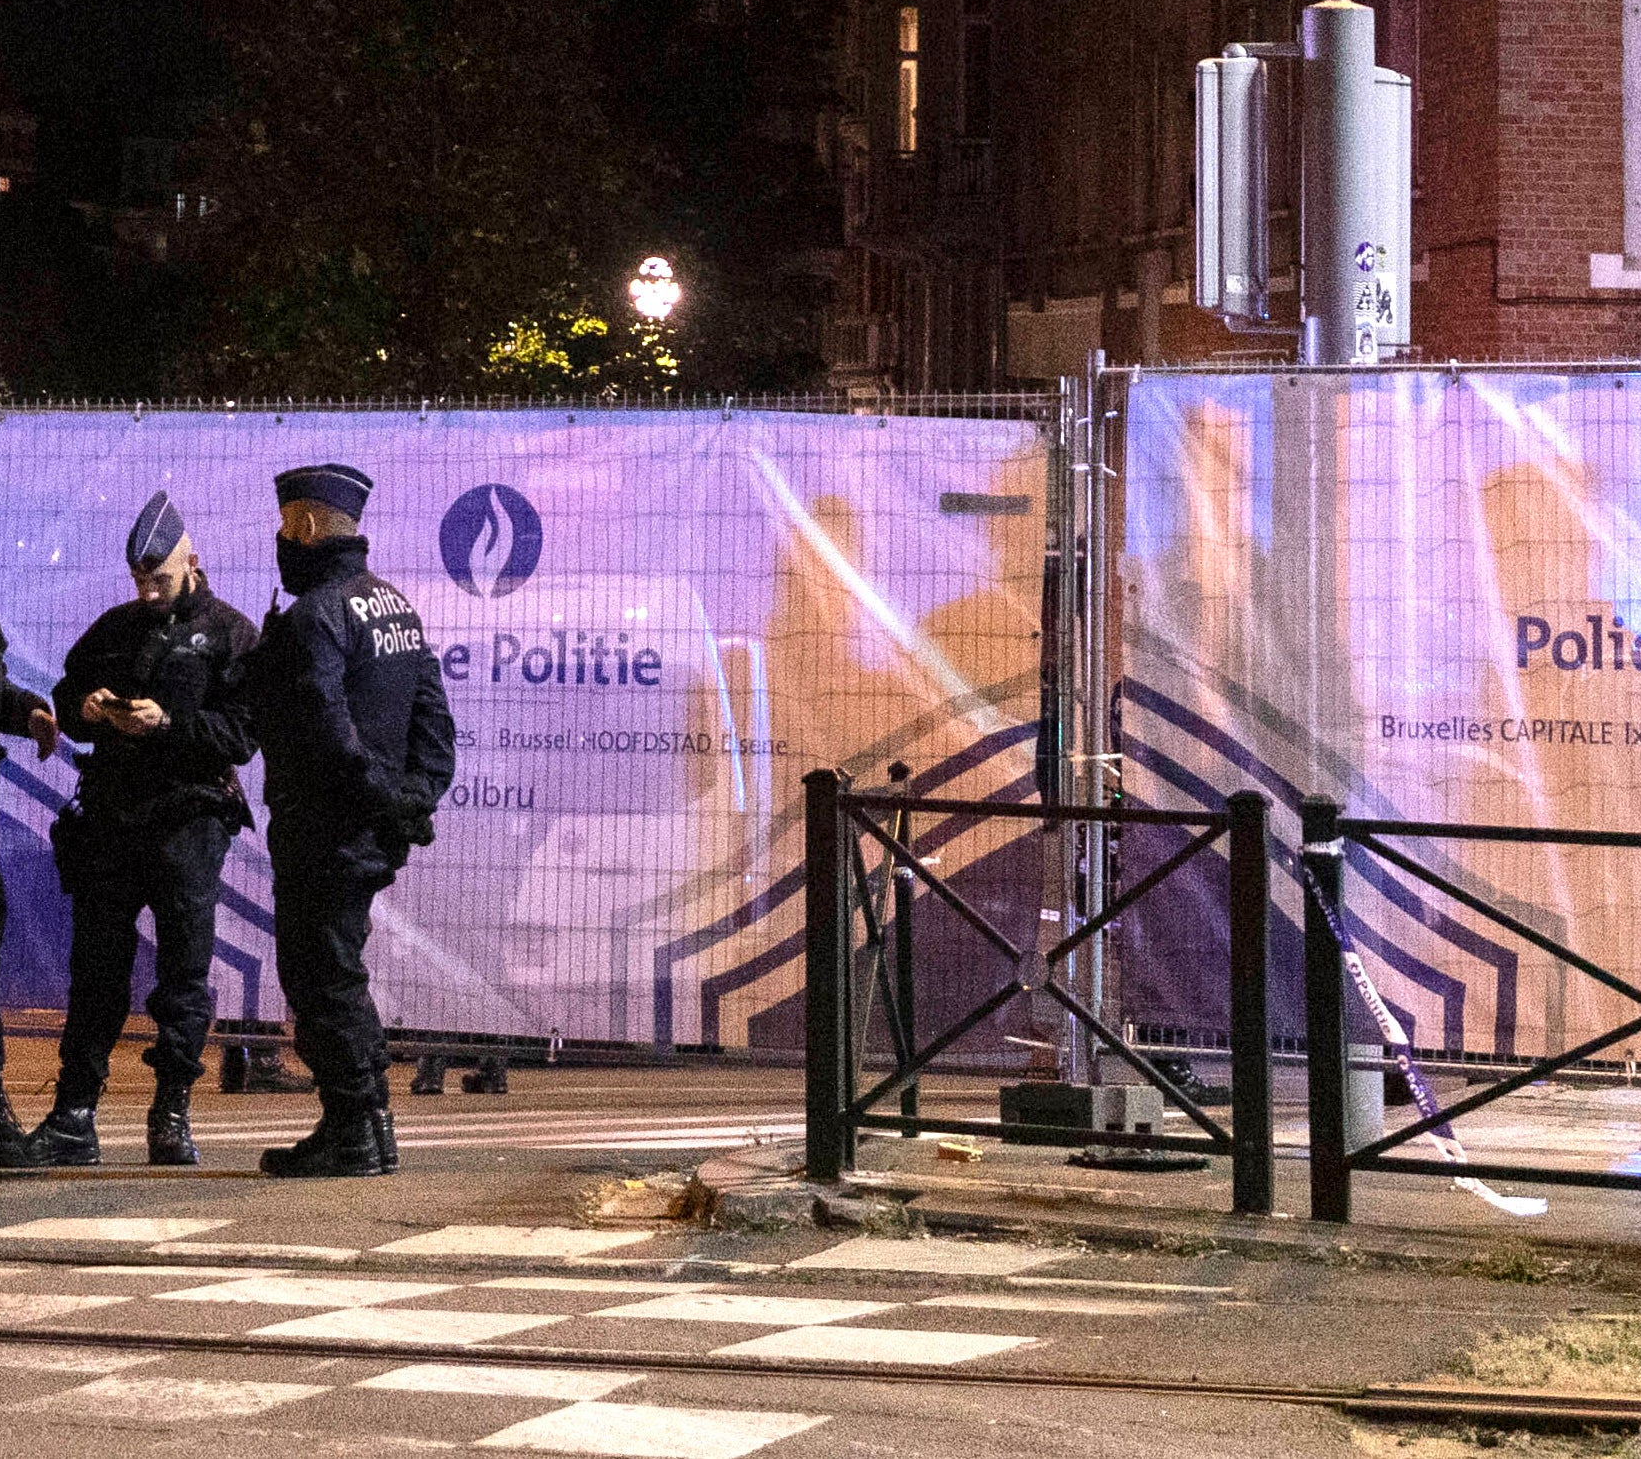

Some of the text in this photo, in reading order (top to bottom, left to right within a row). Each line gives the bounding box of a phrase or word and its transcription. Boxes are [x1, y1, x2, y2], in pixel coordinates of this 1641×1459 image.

[372, 627, 421, 658] Police
[491, 631, 662, 686] Politie
[499, 729, 571, 749] Brussel
[581, 730, 712, 754] HOOFDSTAD
[1380, 714, 1493, 743] Bruxelles
[1500, 717, 1613, 745] CAPITALE
[451, 776, 535, 810] olbru
